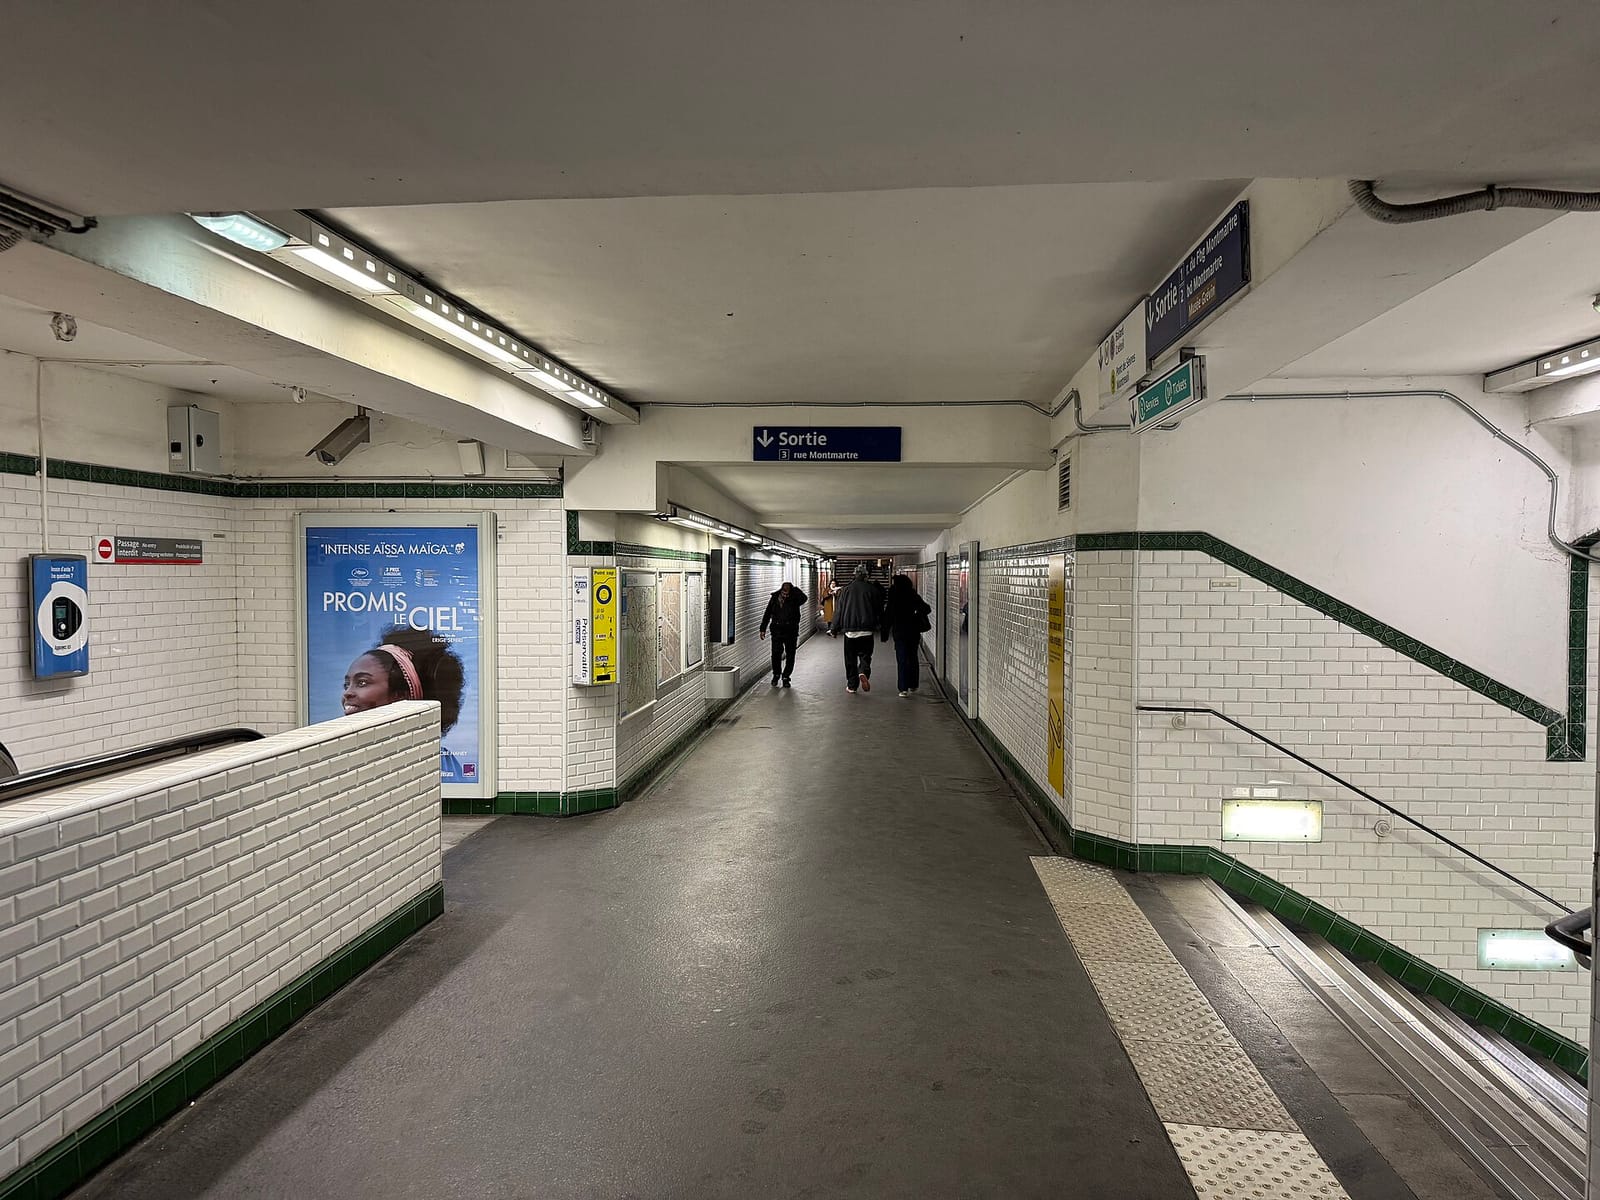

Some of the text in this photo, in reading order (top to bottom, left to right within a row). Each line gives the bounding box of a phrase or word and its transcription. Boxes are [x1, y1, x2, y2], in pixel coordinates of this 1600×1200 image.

[1206, 214, 1238, 256] Montmartre
[1186, 280, 1193, 298] bd
[1193, 255, 1223, 292] Montmartre
[1155, 282, 1178, 323] Sortie
[1172, 379, 1187, 395] Tickets
[779, 431, 827, 446] Sortie
[781, 450, 859, 460] 3 rue Montmartre
[118, 539, 140, 550] Passage
[373, 541, 406, 555] AÏSSA
[118, 549, 139, 558] interdit
[323, 591, 408, 612] PROMIS
[394, 613, 407, 625] LE
[408, 605, 464, 631] CIEL
